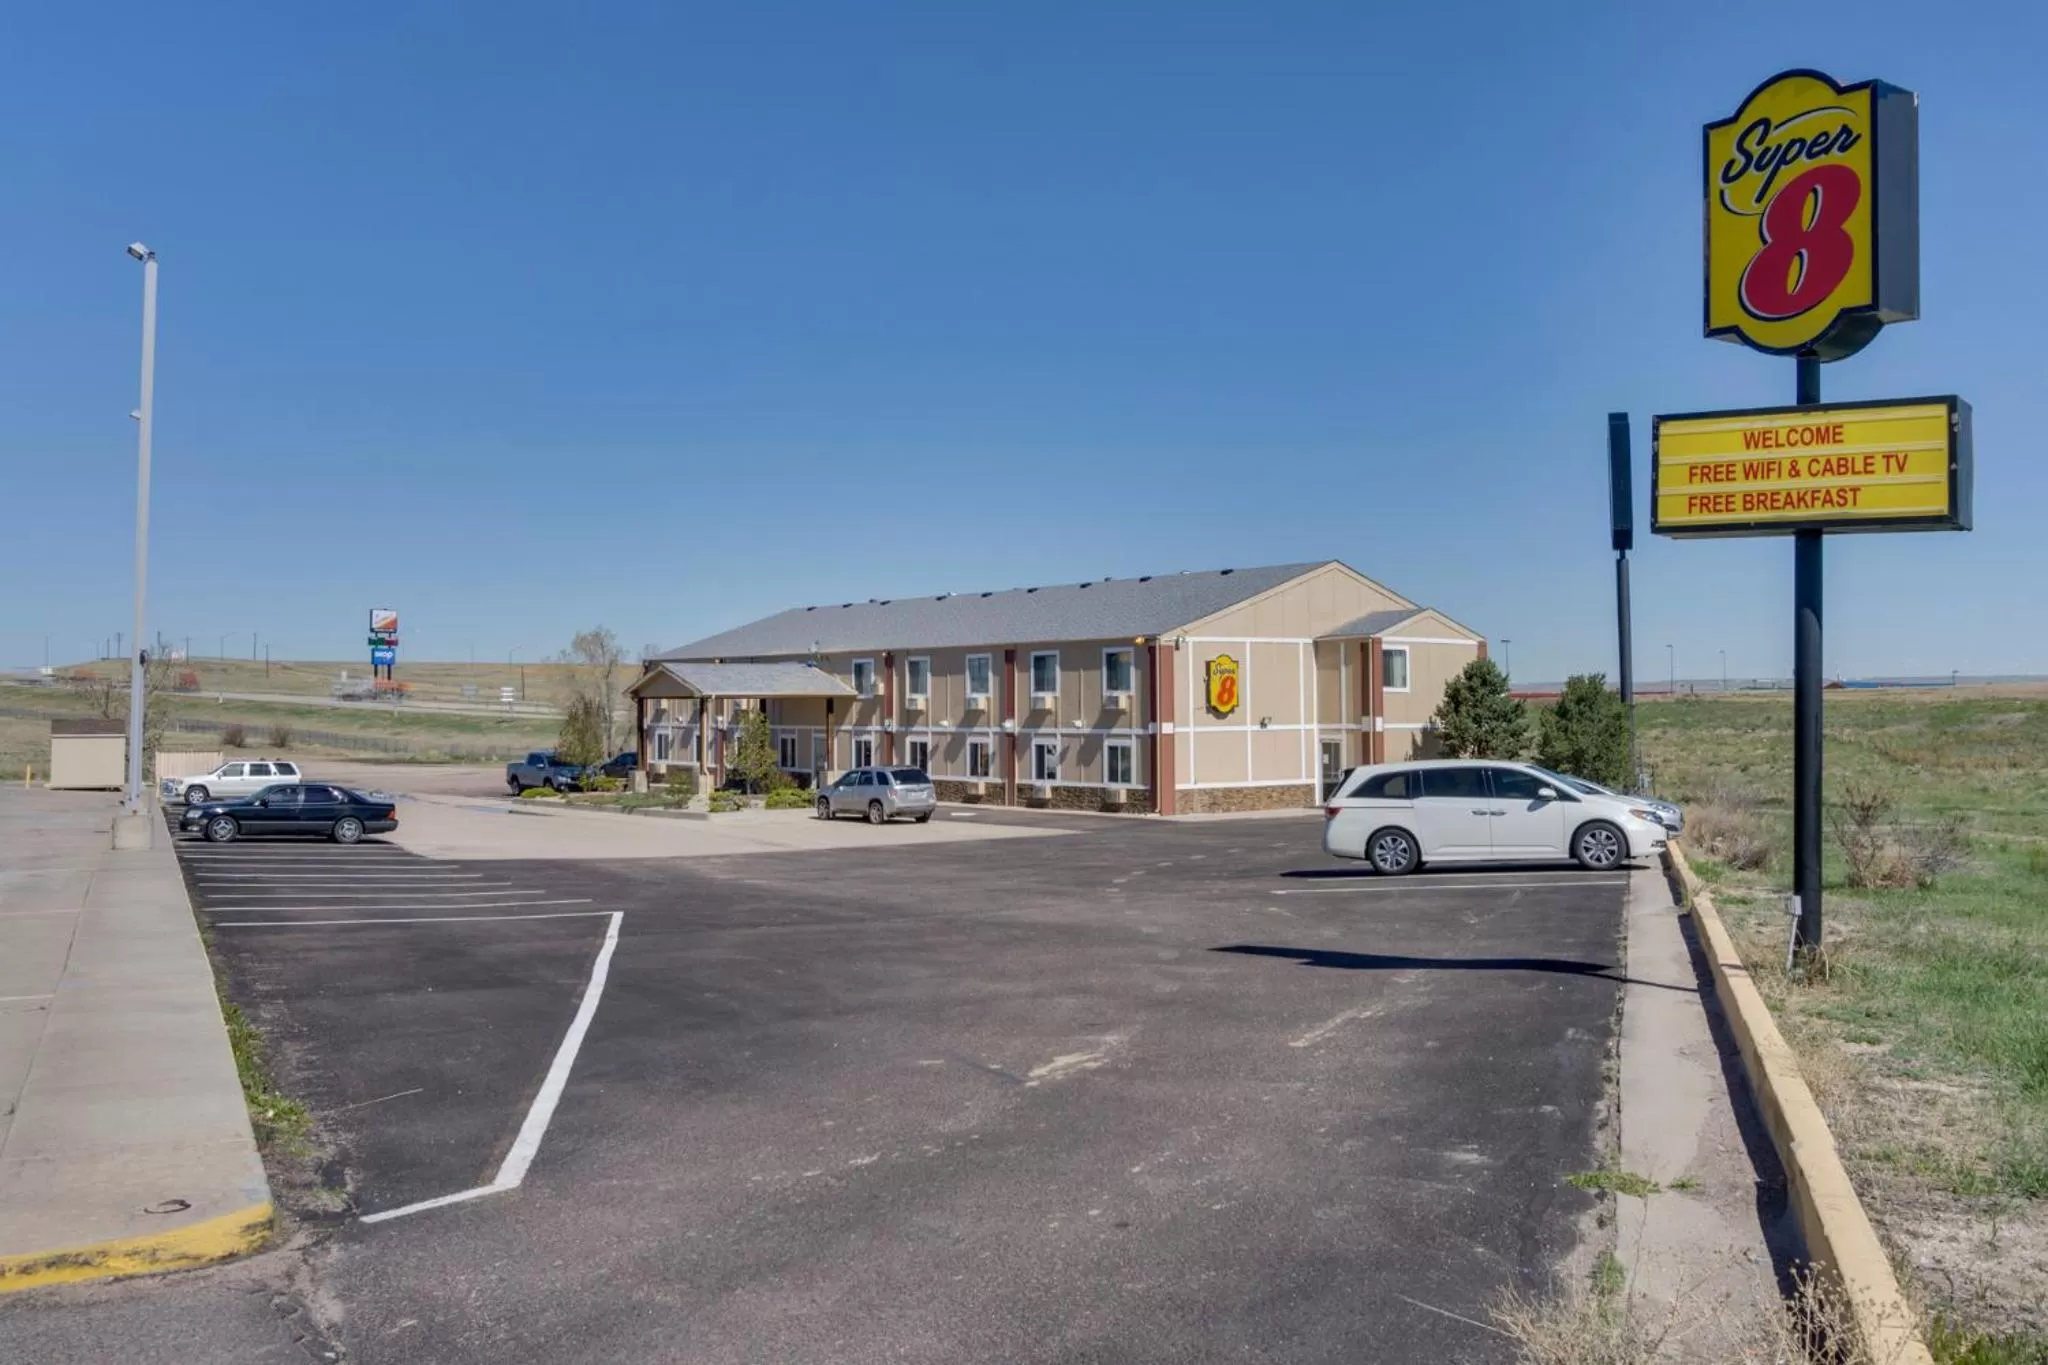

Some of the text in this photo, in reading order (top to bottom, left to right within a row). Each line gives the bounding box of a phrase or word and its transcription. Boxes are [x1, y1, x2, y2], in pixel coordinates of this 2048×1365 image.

[1720, 117, 1862, 203] Super
[1738, 164, 1861, 322] 8
[1744, 425, 1844, 450] WELCOME
[1688, 453, 1908, 484] FREE WIFI & CABLE TV
[1688, 487, 1861, 515] FREE BREAKFAST
[1217, 675, 1236, 707] 8
